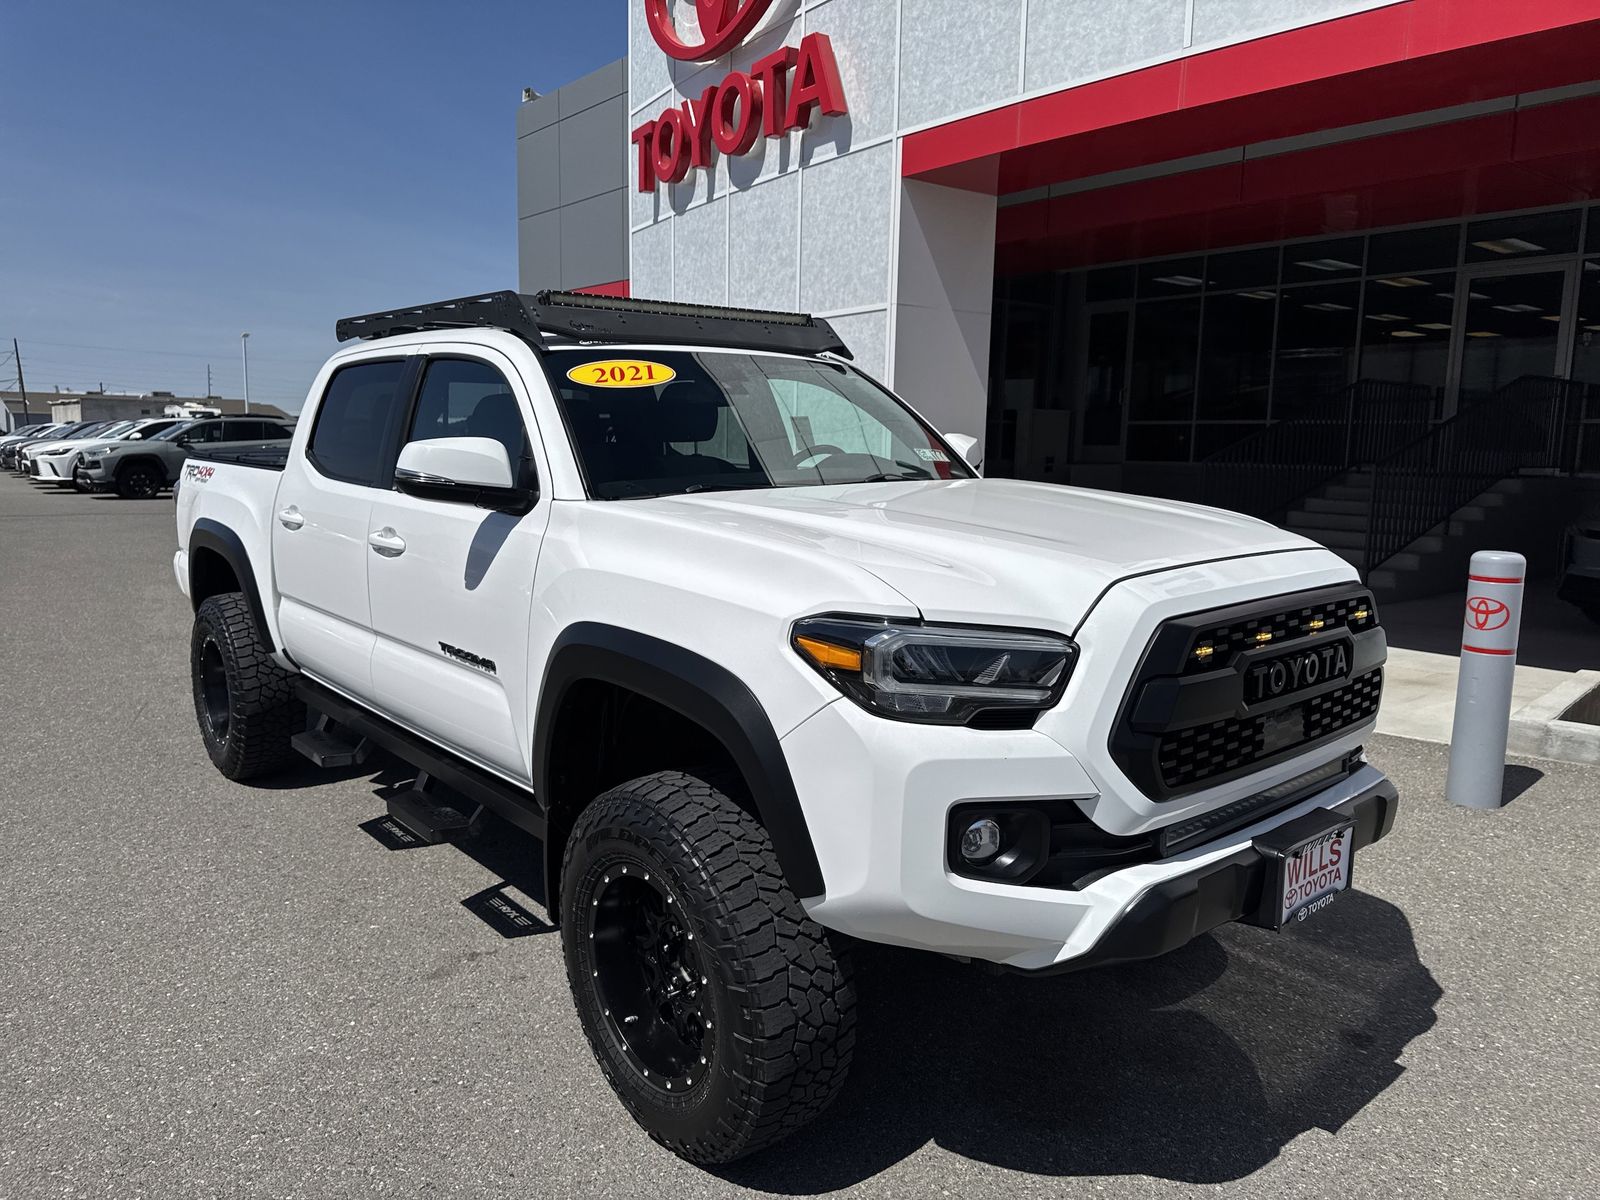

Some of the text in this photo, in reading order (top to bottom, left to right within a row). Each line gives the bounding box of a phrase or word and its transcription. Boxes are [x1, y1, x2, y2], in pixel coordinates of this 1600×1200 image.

[632, 32, 848, 193] TOYOTA
[592, 364, 658, 384] 2021
[1253, 645, 1348, 699] TOYOTA
[1287, 838, 1342, 888] WILLS
[1298, 867, 1342, 901] TOYOTA
[1308, 892, 1335, 915] TOYOTA
